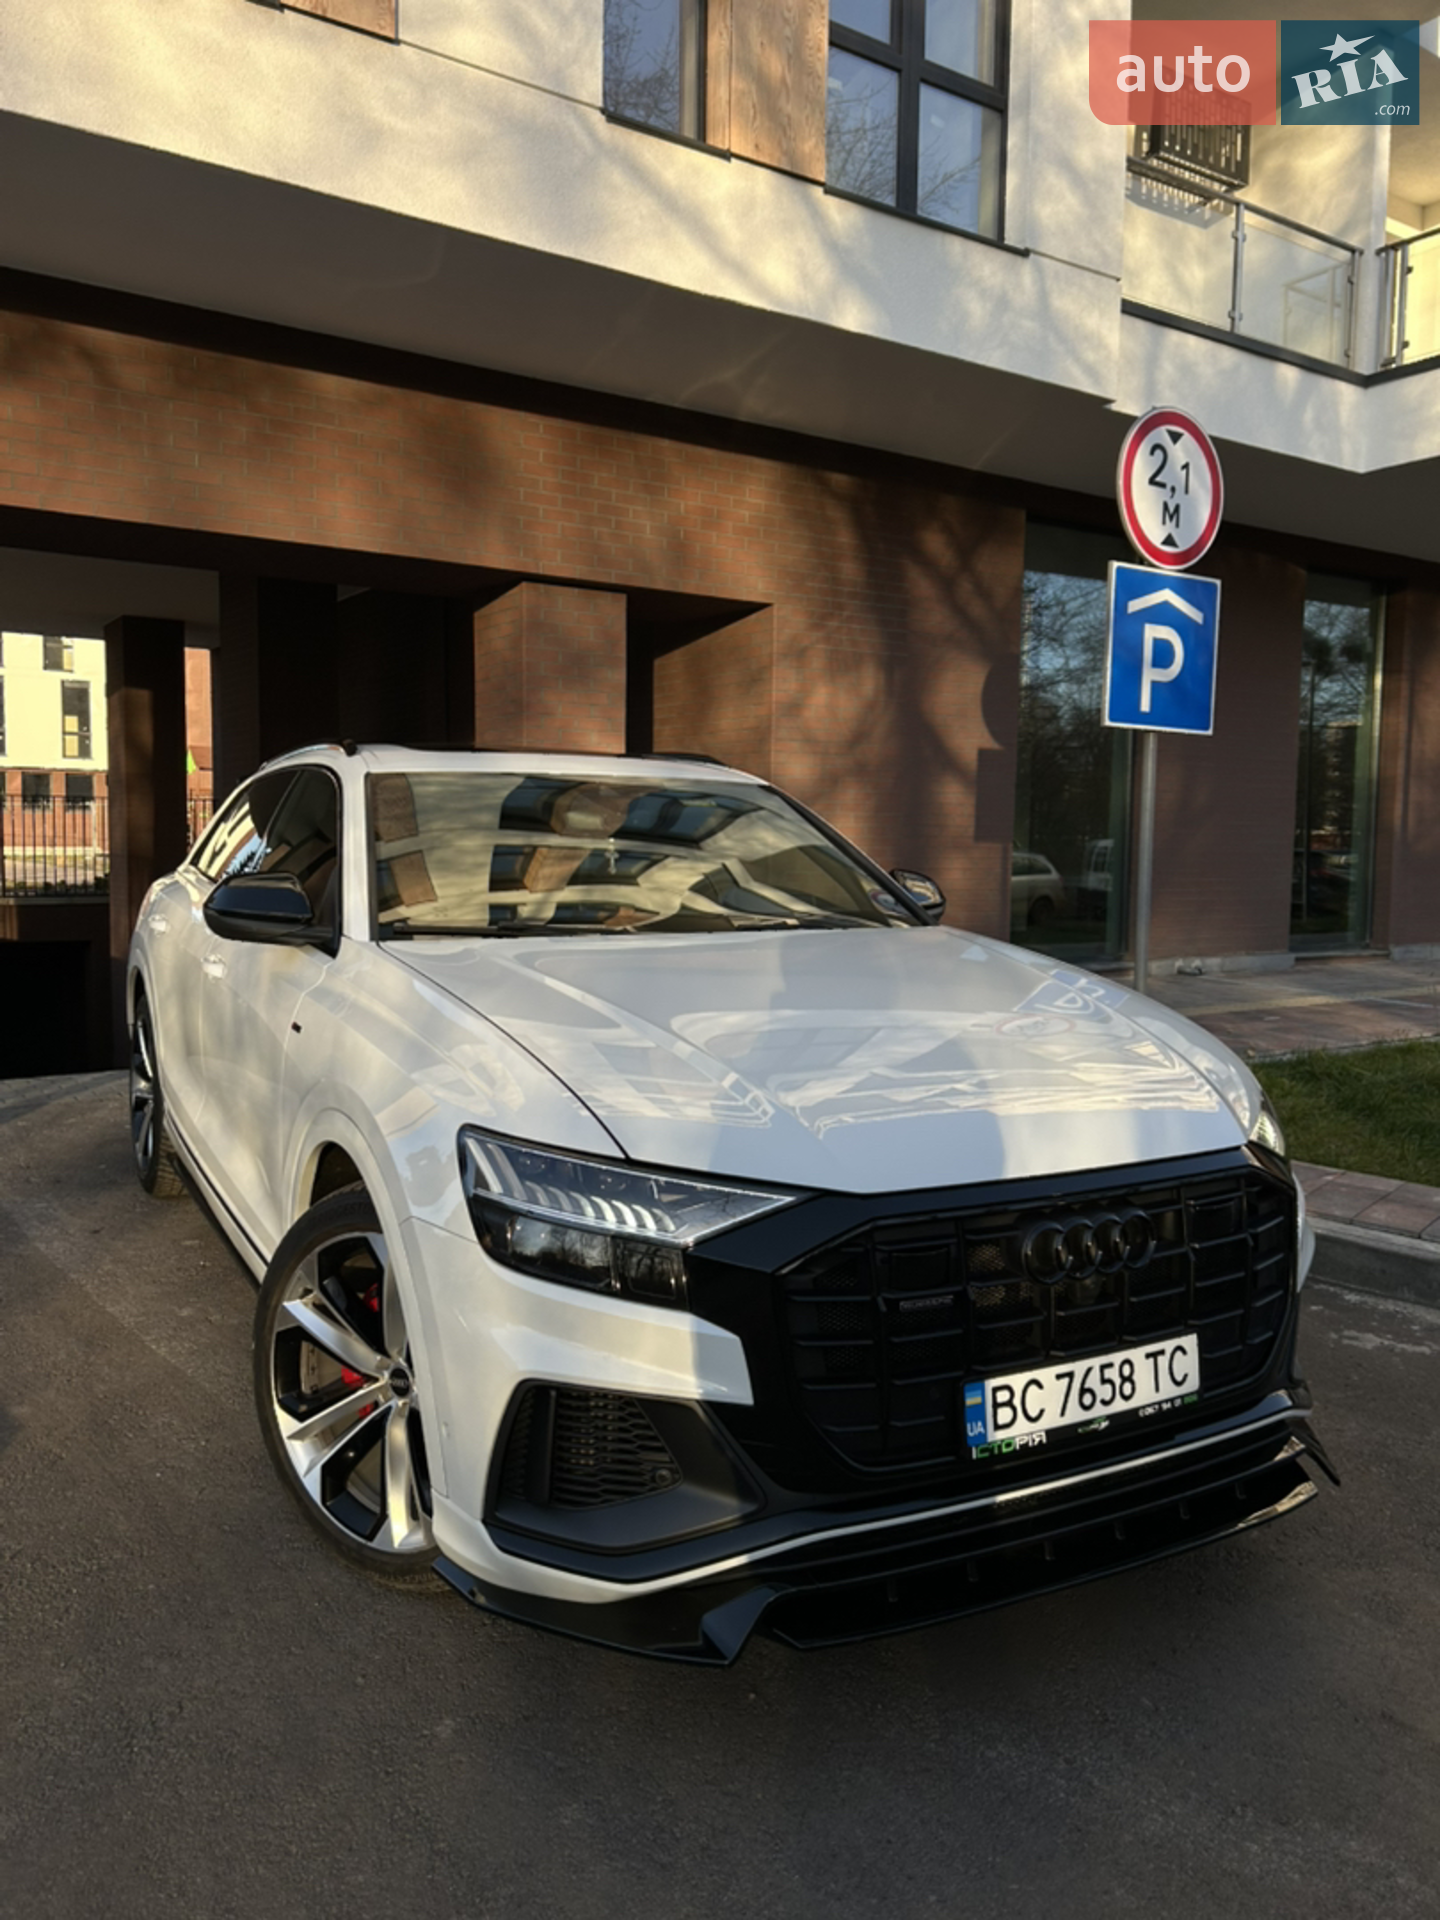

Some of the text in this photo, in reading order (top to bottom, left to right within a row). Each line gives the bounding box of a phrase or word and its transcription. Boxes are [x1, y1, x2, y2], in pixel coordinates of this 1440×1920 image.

[1148, 442, 1190, 498] 2,1
[1139, 622, 1185, 713] P
[991, 1378, 1045, 1432] BC
[1055, 1357, 1136, 1418] 7658
[1145, 1344, 1189, 1394] TC
[967, 1421, 985, 1437] UA
